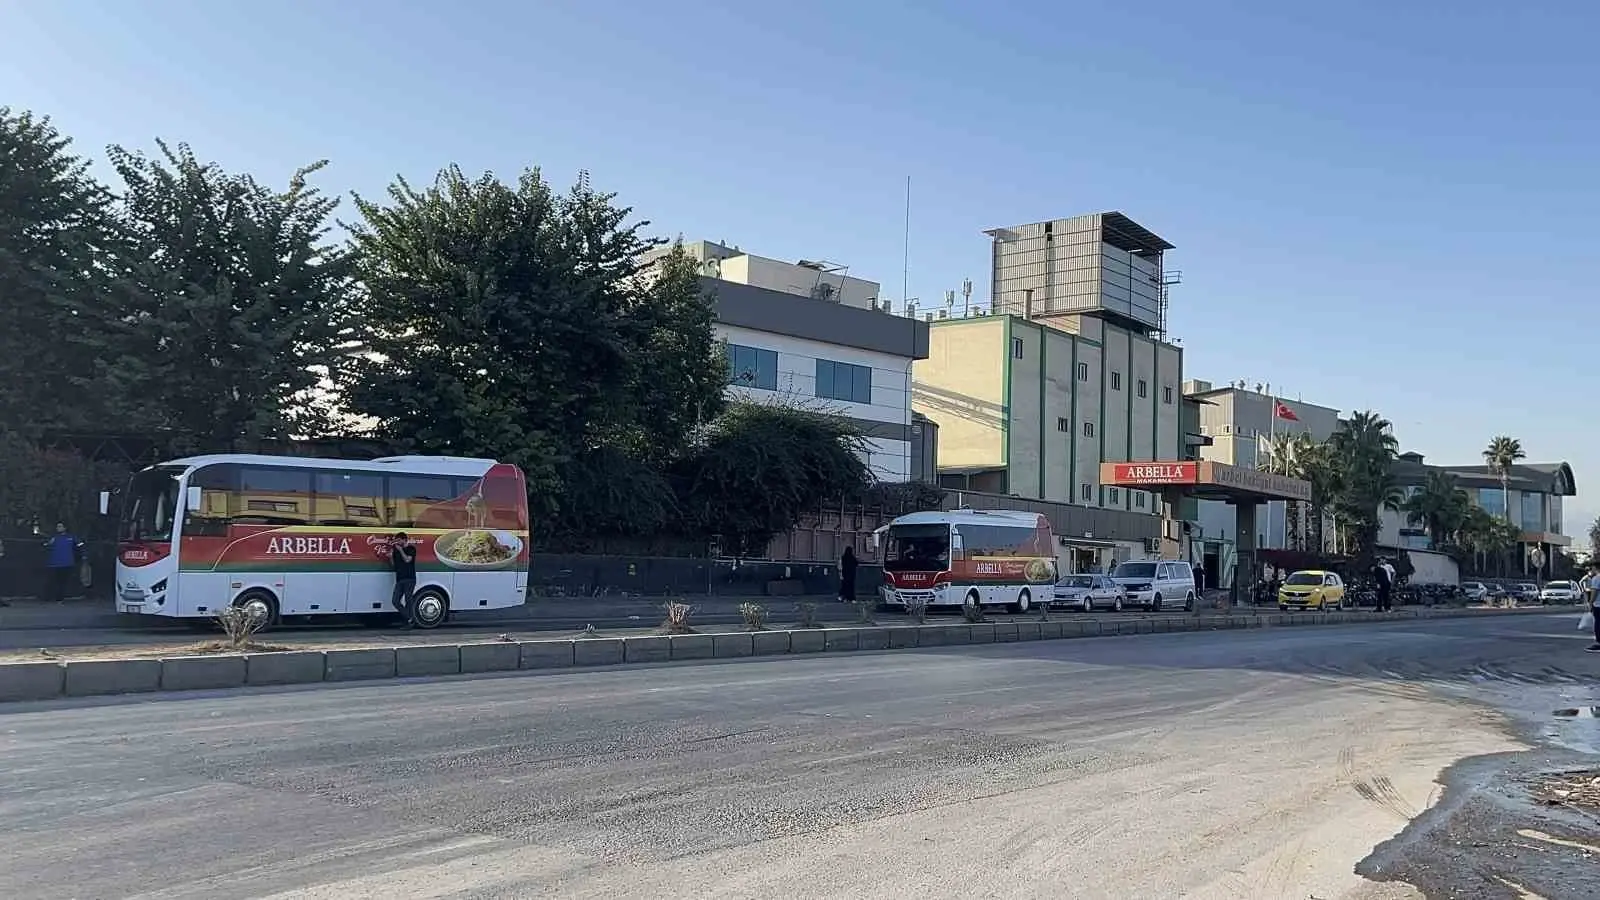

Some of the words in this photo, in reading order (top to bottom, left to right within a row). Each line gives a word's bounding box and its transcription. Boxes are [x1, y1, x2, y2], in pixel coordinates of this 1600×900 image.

[1126, 465, 1183, 478] ARBELLA
[266, 537, 352, 555] ARBELLA
[976, 563, 1002, 575] ARBELLA
